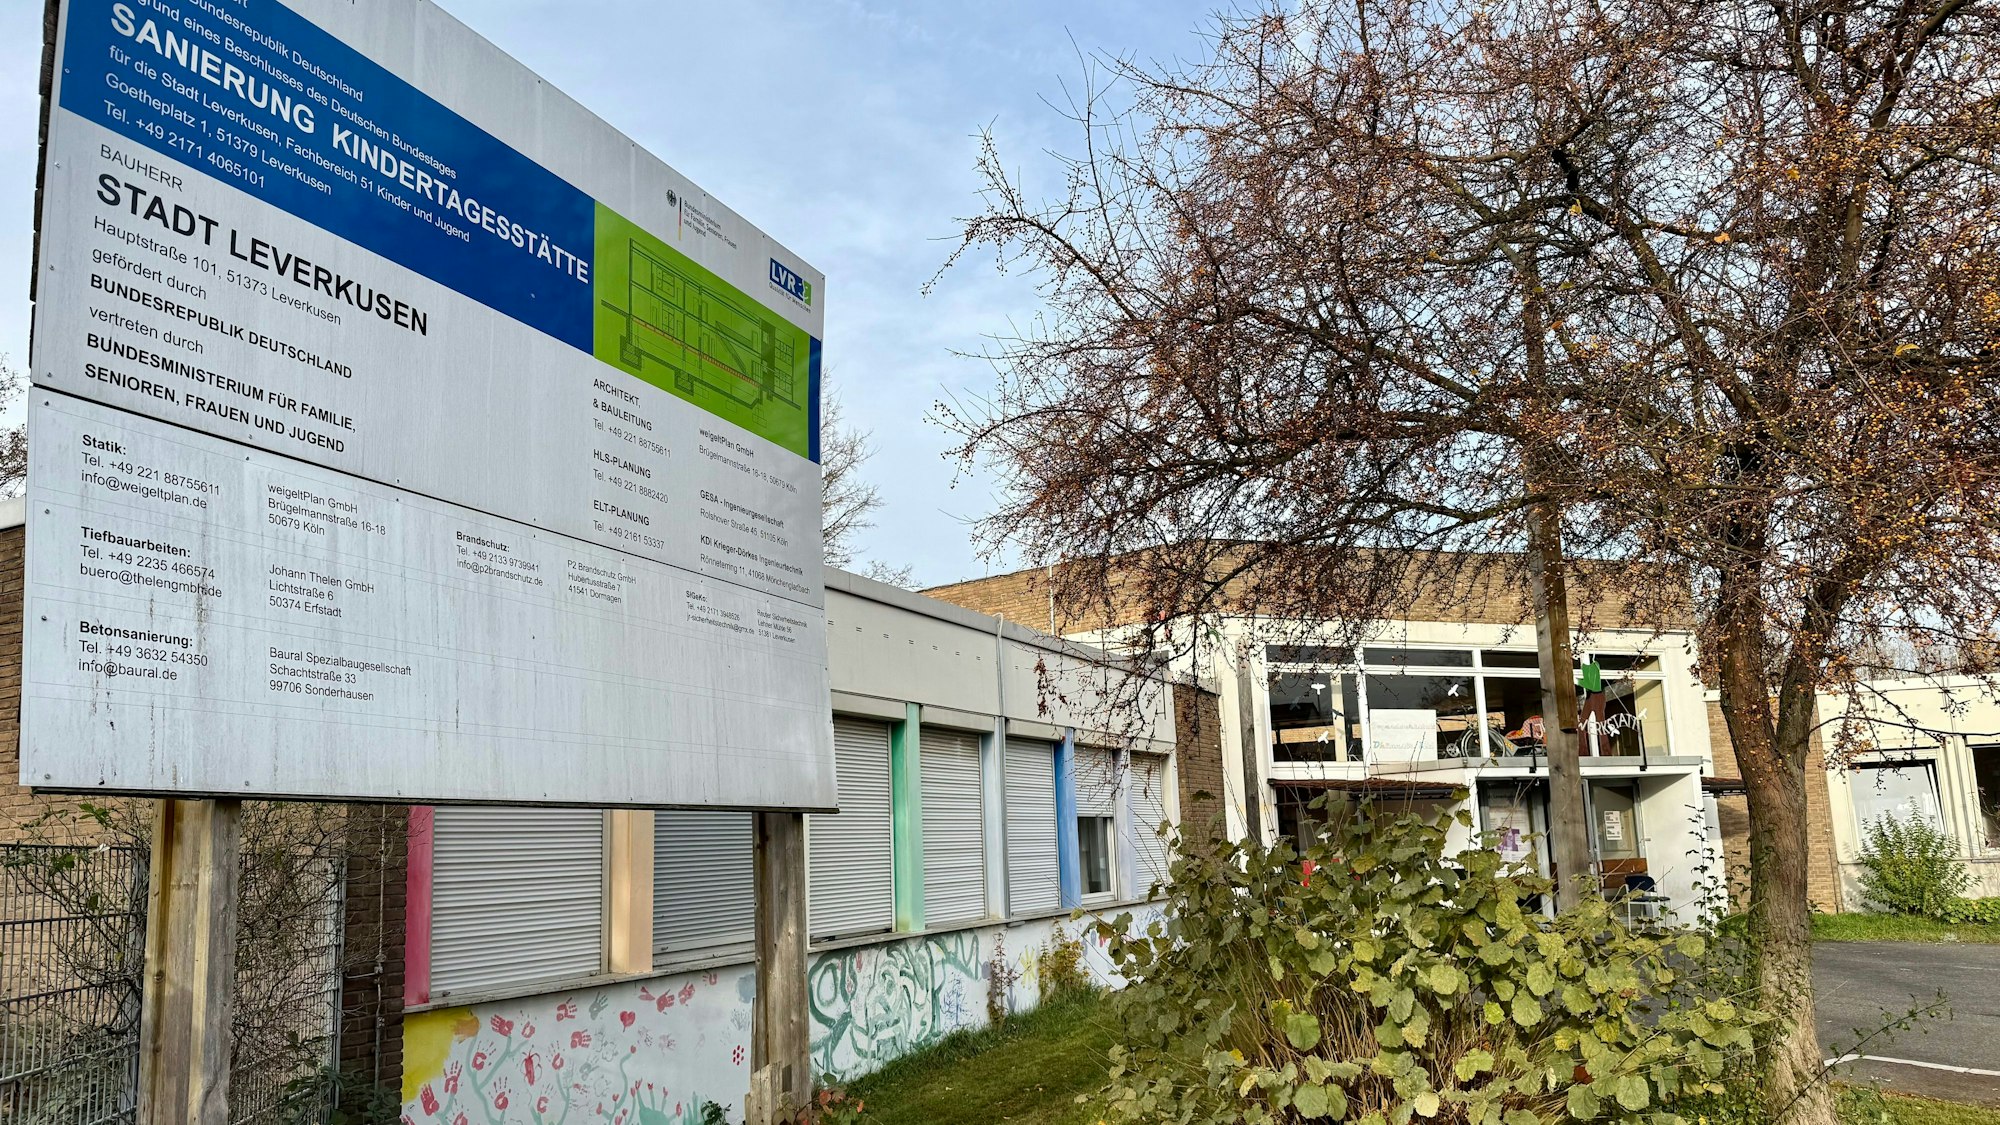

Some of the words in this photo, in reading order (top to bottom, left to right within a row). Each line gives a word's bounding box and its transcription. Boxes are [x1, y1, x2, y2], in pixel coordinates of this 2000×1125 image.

[292, 50, 363, 102] Deutschland
[183, 16, 221, 45] eines
[224, 36, 304, 92] Beschlusses
[306, 86, 328, 106] des
[330, 97, 389, 142] Deutschen
[391, 133, 456, 179] Bundestages
[103, 99, 130, 125] Tel.
[135, 118, 164, 140] +49
[167, 131, 202, 158] 2171
[206, 151, 264, 188] 4065101
[105, 72, 196, 128] Goetheplatz
[200, 119, 212, 138] 1,
[216, 127, 258, 158] 51379
[261, 148, 331, 195] Leverkusen
[109, 44, 131, 66] für
[133, 59, 157, 80] die
[160, 71, 199, 103] Stadt
[202, 92, 282, 147] Leverkusen,
[285, 136, 358, 184] Fachbereich
[359, 175, 373, 192] 51
[377, 184, 412, 211] Kinder
[413, 205, 433, 223] und
[434, 216, 470, 242] Jugend
[110, 2, 314, 134] SANIERUNG
[332, 122, 588, 284] KINDERTAGESSTÄTTE
[100, 143, 183, 192] BAUHERR
[94, 215, 187, 264] Hauptstraße
[193, 255, 221, 279] 101,
[226, 268, 268, 296] 51373
[271, 286, 341, 326] Leverkusen
[96, 173, 219, 246] STADT
[229, 228, 427, 336] LEVERKUSEN
[92, 248, 162, 284] gefördert
[166, 275, 206, 300] durch
[772, 261, 796, 294] LVR
[89, 306, 158, 339] vertreten
[162, 330, 203, 354] durch
[90, 273, 244, 341] BUNDESREPUBLIK
[248, 330, 352, 379] DEUTSCHLAND
[87, 332, 264, 402] BUNDESMINISTERIUM
[268, 391, 297, 413] FÜR
[300, 402, 356, 432] FAMILIE,
[592, 377, 640, 408] ARCHITEKT,
[84, 363, 179, 406] SENIOREN,
[185, 392, 250, 425] FRAUEN
[254, 414, 285, 435] UND
[288, 425, 344, 453] JUGEND
[592, 397, 599, 409] &
[600, 400, 652, 431] BAULEITUNG
[82, 433, 126, 455] Statik:
[592, 417, 606, 432] Tel.
[607, 425, 622, 438] +49
[622, 430, 636, 443] 221
[638, 436, 671, 457] 88755611
[81, 451, 104, 468] Tel.
[108, 460, 133, 475] +49
[136, 465, 159, 481] 221
[163, 471, 219, 495] 88755611
[593, 448, 651, 479] HLS-PLANUNG
[81, 469, 207, 509] info@weigeltplan.de
[267, 484, 325, 506] weigeltPlan
[327, 497, 358, 514] GmbH
[592, 467, 606, 482] Tel.
[607, 475, 623, 488] +49
[623, 479, 637, 493] 221
[638, 484, 669, 504] 8882420
[268, 496, 358, 529] Brügelmannstraße
[360, 520, 386, 536] 16-18
[268, 512, 300, 530] 50679
[302, 520, 325, 535] Köln
[593, 499, 650, 526] ELT-PLANUNG
[80, 525, 190, 558] Tiefbauarbeiten:
[456, 530, 510, 552] Brandschutz:
[592, 519, 606, 533] Tel.
[608, 526, 623, 538] +49
[623, 528, 641, 543] 2161
[642, 534, 665, 550] 53337
[79, 544, 103, 560] Tel.
[108, 551, 133, 565] +49
[136, 554, 168, 571] 2235
[170, 561, 215, 580] 466574
[456, 544, 468, 556] Tel.
[472, 549, 487, 561] +49
[488, 551, 508, 566] 2133
[508, 556, 539, 571] 9739941
[456, 559, 543, 587] info@p2brandschutz.de
[567, 559, 577, 570] P2
[577, 561, 617, 580] Brandschutz
[617, 571, 636, 584] GmbH
[79, 562, 222, 598] buero@thelengmbh.de
[268, 563, 306, 581] Johann
[308, 570, 342, 587] Thelen
[344, 578, 374, 593] GmbH
[268, 578, 325, 600] Lichtstraße
[326, 589, 334, 601] 6
[567, 571, 616, 591] Hubertusstraße
[616, 583, 621, 592] 7
[567, 583, 588, 596] 41541
[589, 588, 622, 604] Dormagen
[269, 594, 301, 609] 50374
[304, 600, 342, 618] Erfstadt
[79, 620, 193, 649] Betonsanierung:
[78, 639, 102, 654] Tel.
[106, 642, 132, 658] +49
[135, 646, 167, 662] 3632
[170, 650, 208, 666] 54350
[269, 646, 303, 662] Baural
[305, 651, 411, 676] Spezialbaugesellschaft
[78, 658, 177, 681] info@baural.de
[269, 662, 342, 682] Schachtstraße
[344, 672, 356, 684] 33
[269, 678, 302, 694] 99706
[304, 682, 374, 701] Sonderhausen
